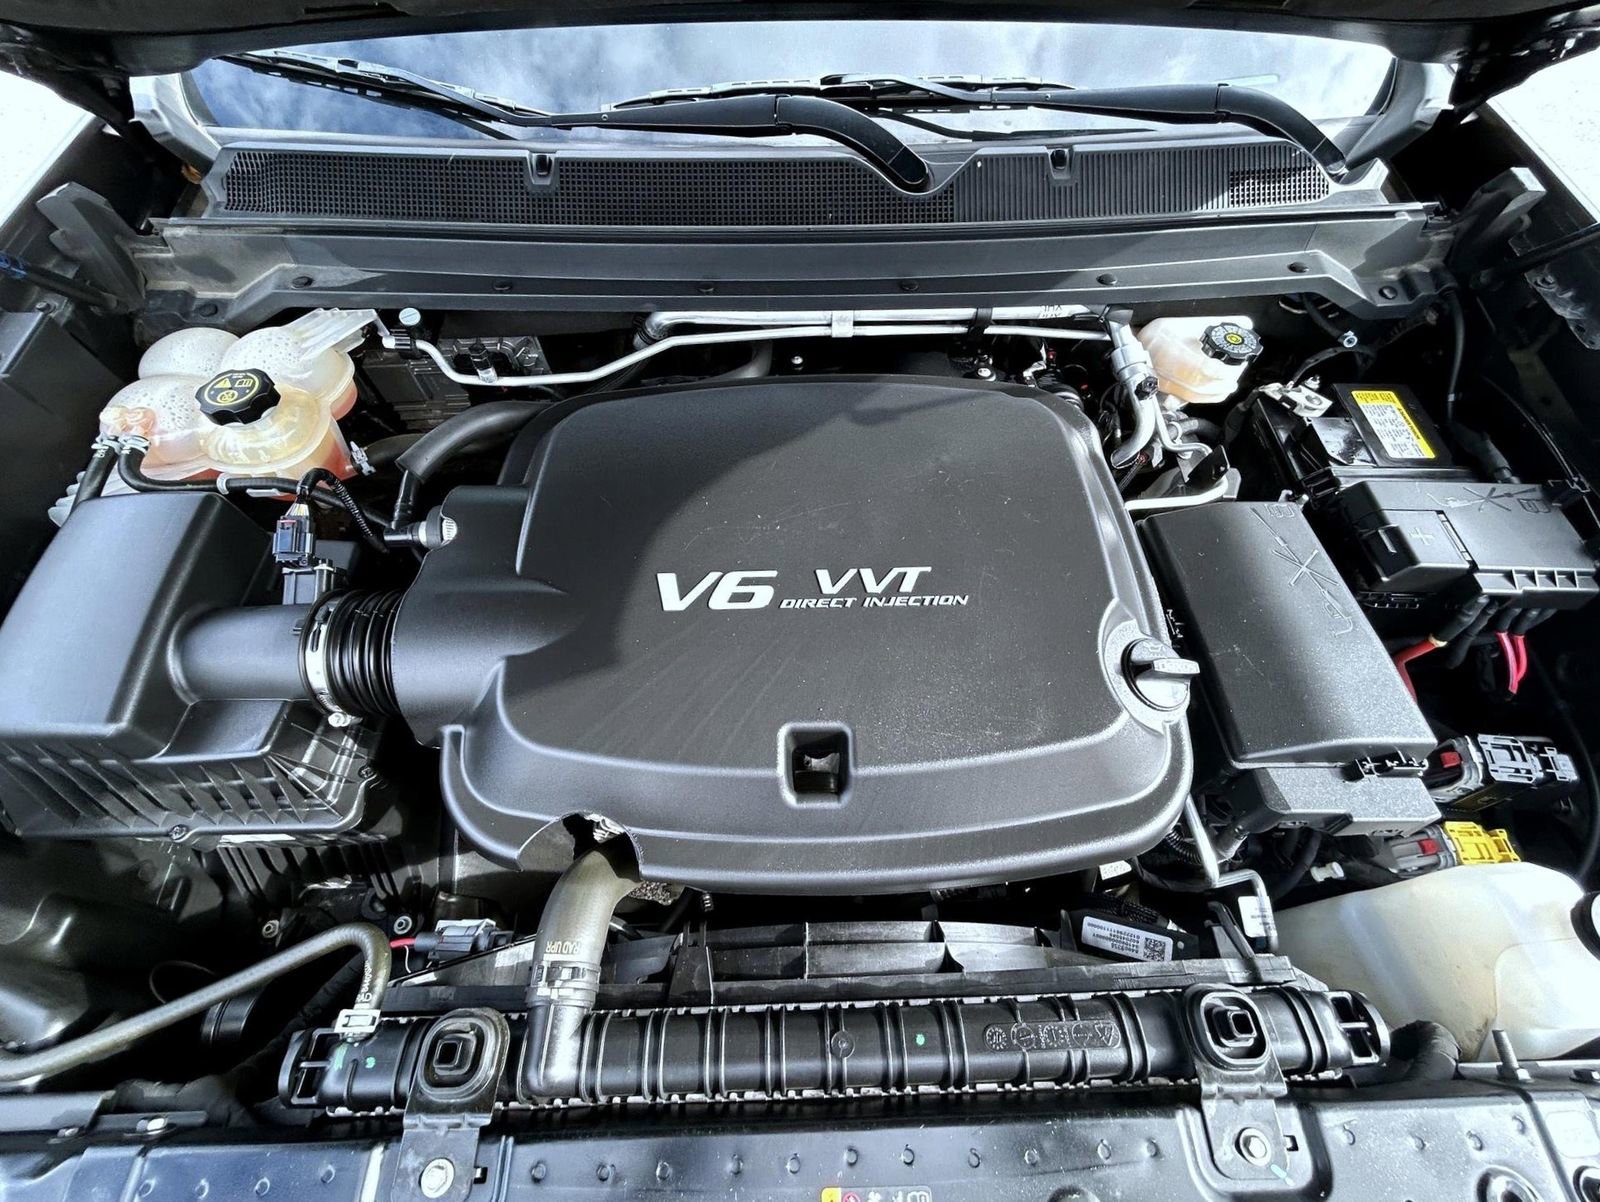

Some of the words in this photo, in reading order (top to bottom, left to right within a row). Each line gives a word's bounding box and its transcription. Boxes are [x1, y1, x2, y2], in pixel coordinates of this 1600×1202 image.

[815, 566, 932, 594] VVT
[656, 570, 778, 611] V6
[779, 597, 857, 609] DIRECT
[862, 595, 968, 608] INJECTION
[545, 941, 562, 953] UPR
[562, 940, 581, 953] RAD
